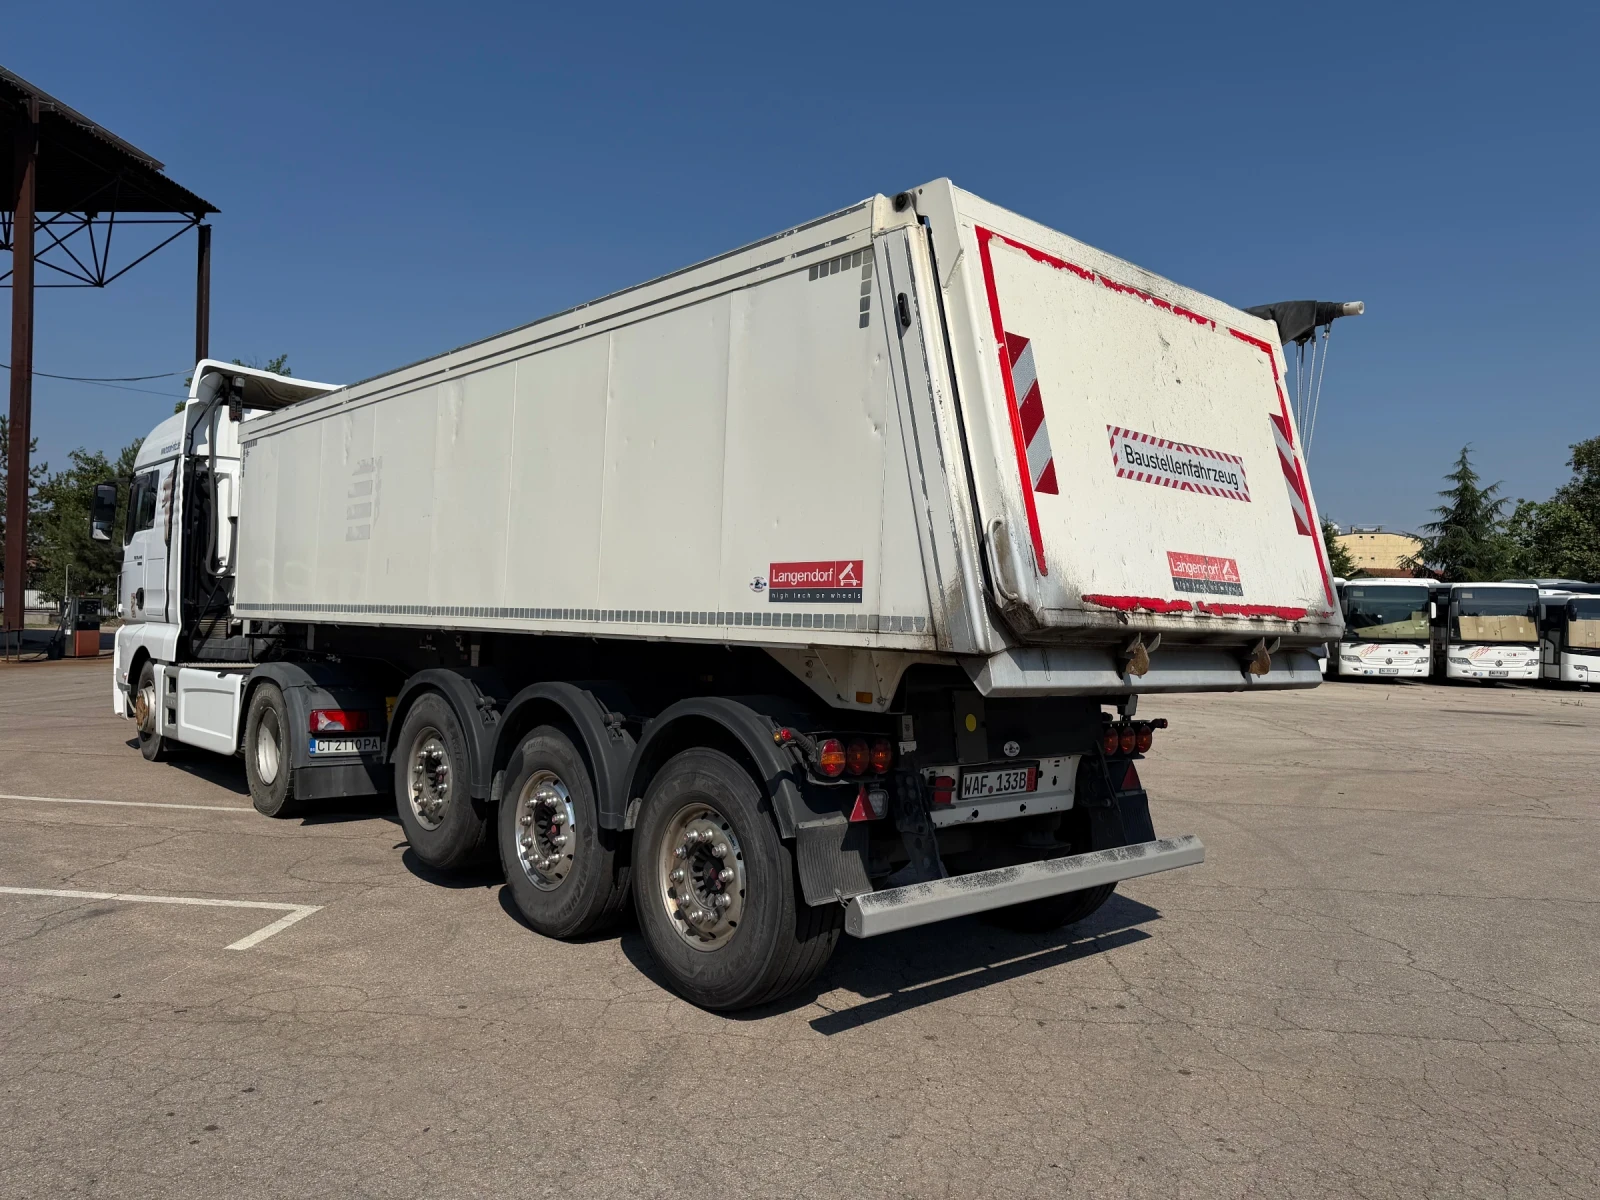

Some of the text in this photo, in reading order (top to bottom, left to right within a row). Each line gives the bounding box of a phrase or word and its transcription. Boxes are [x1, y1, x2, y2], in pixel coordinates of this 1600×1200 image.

[1124, 444, 1239, 490] Baustellenfahrzeug
[772, 567, 834, 586] Langendorf
[771, 592, 789, 600] high
[793, 591, 811, 599] tech
[830, 591, 861, 599] wheels
[964, 774, 989, 796] WAF
[995, 771, 1027, 792] 133B
